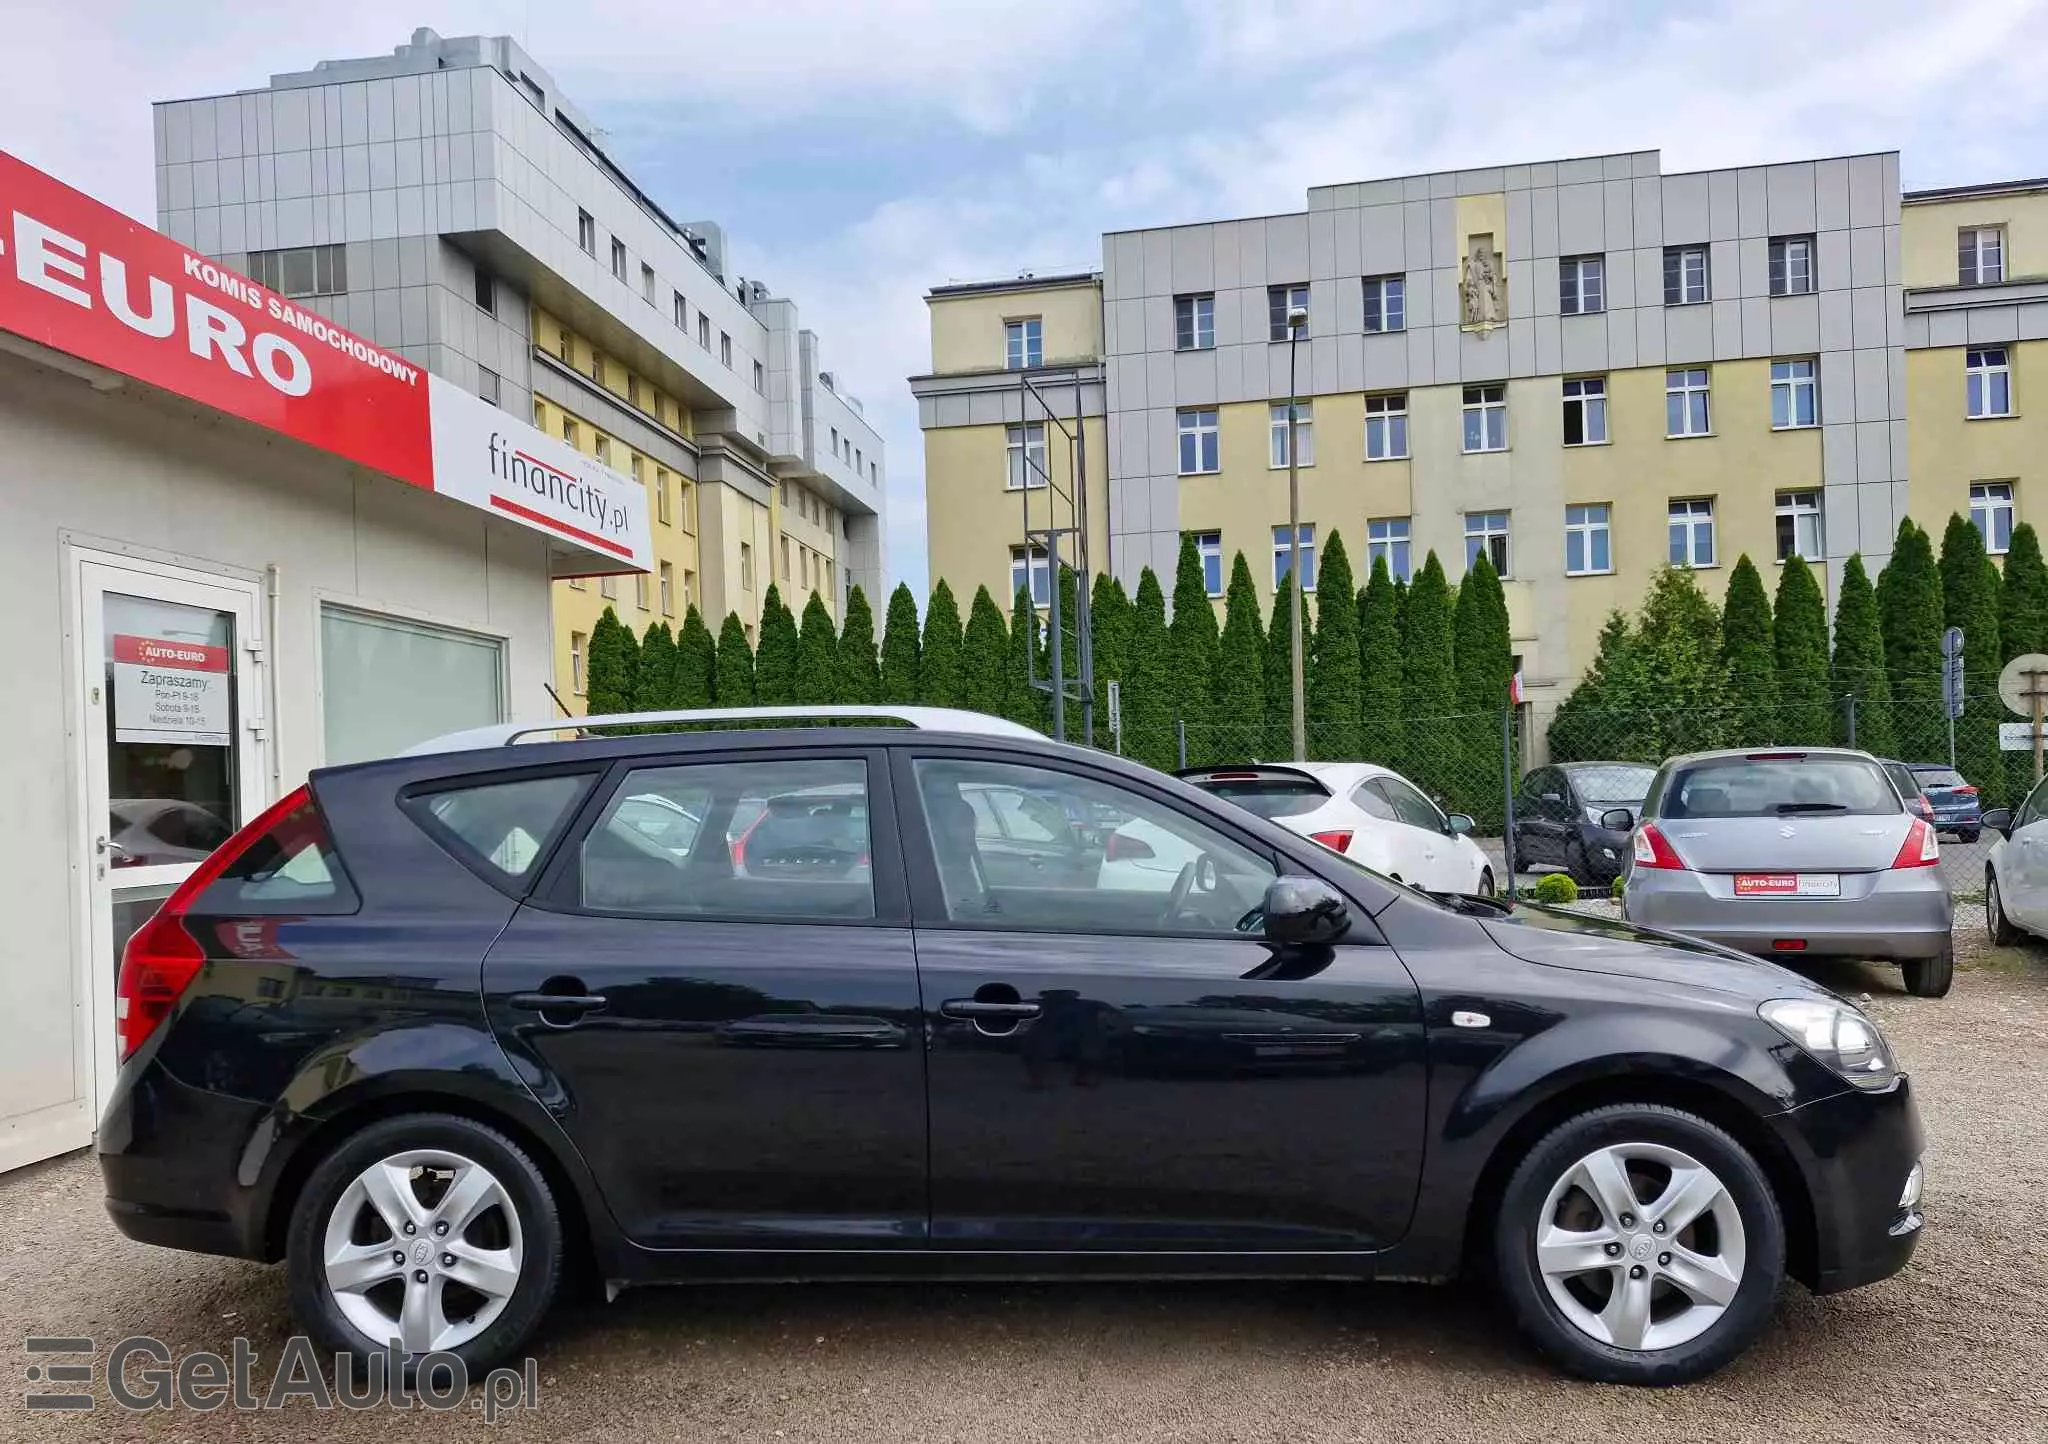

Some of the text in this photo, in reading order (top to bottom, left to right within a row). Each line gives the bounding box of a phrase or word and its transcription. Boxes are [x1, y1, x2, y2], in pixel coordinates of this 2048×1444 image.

[0, 209, 313, 398] EURO
[184, 253, 418, 387] KOMIS SAMOCHODOWY
[488, 432, 629, 535] financity.pl
[145, 646, 206, 663] AUTO-EURO
[1741, 879, 1795, 888] AUTO-EURO
